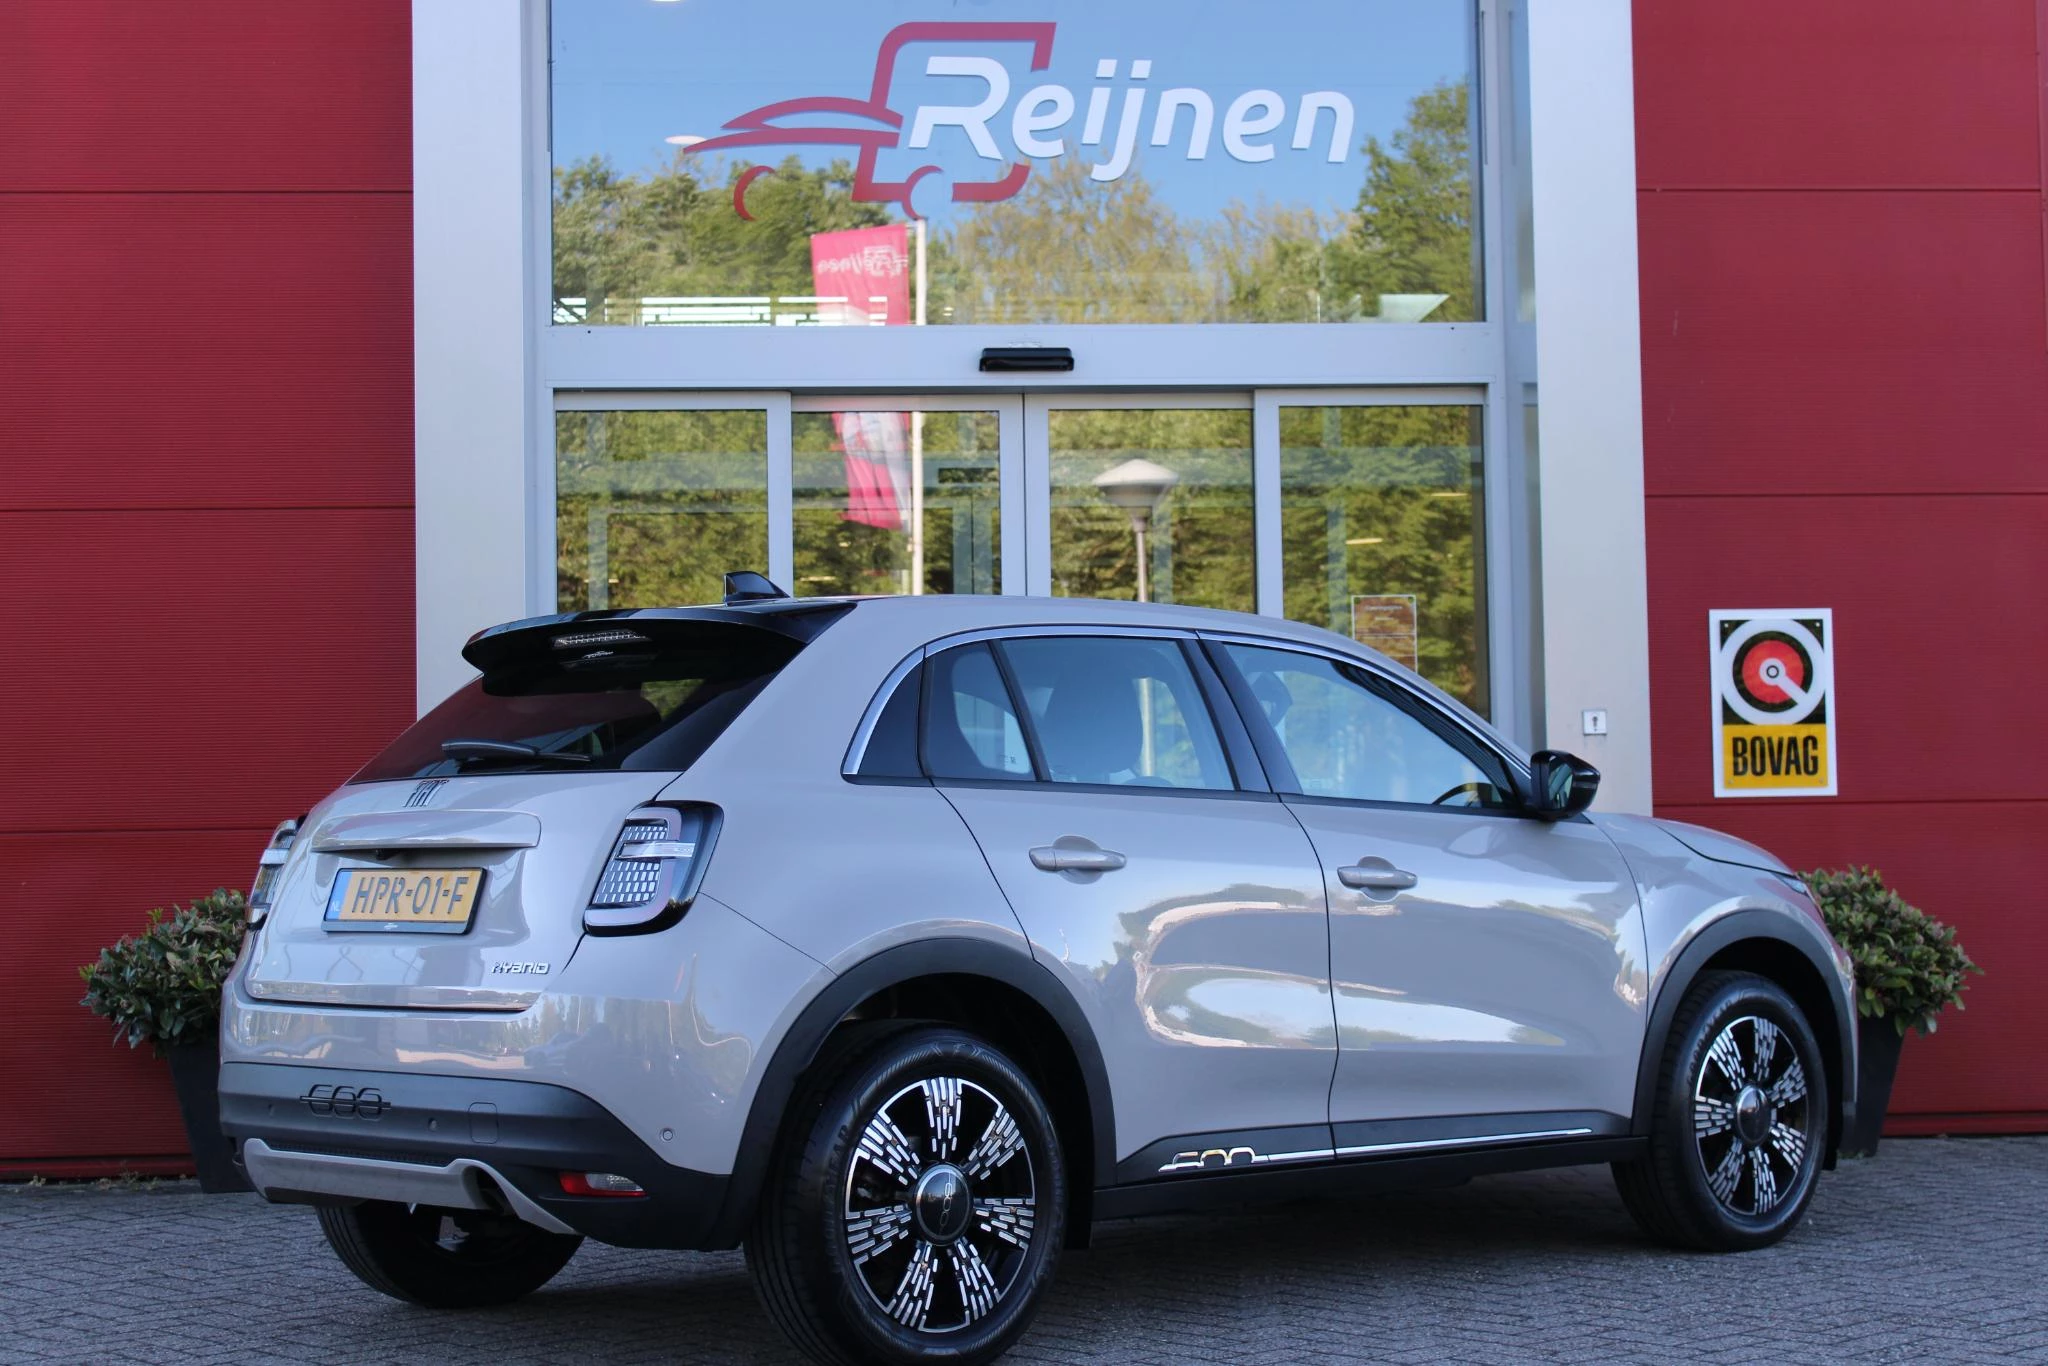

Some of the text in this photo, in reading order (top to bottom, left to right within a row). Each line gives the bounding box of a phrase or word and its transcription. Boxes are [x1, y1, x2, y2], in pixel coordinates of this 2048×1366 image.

[909, 56, 1356, 182] Reijnen
[1732, 735, 1819, 776] BOVAG
[403, 779, 450, 808] FIAT
[330, 901, 341, 912] NL
[351, 876, 469, 914] HPR-01-F
[491, 961, 551, 974] HYBRID
